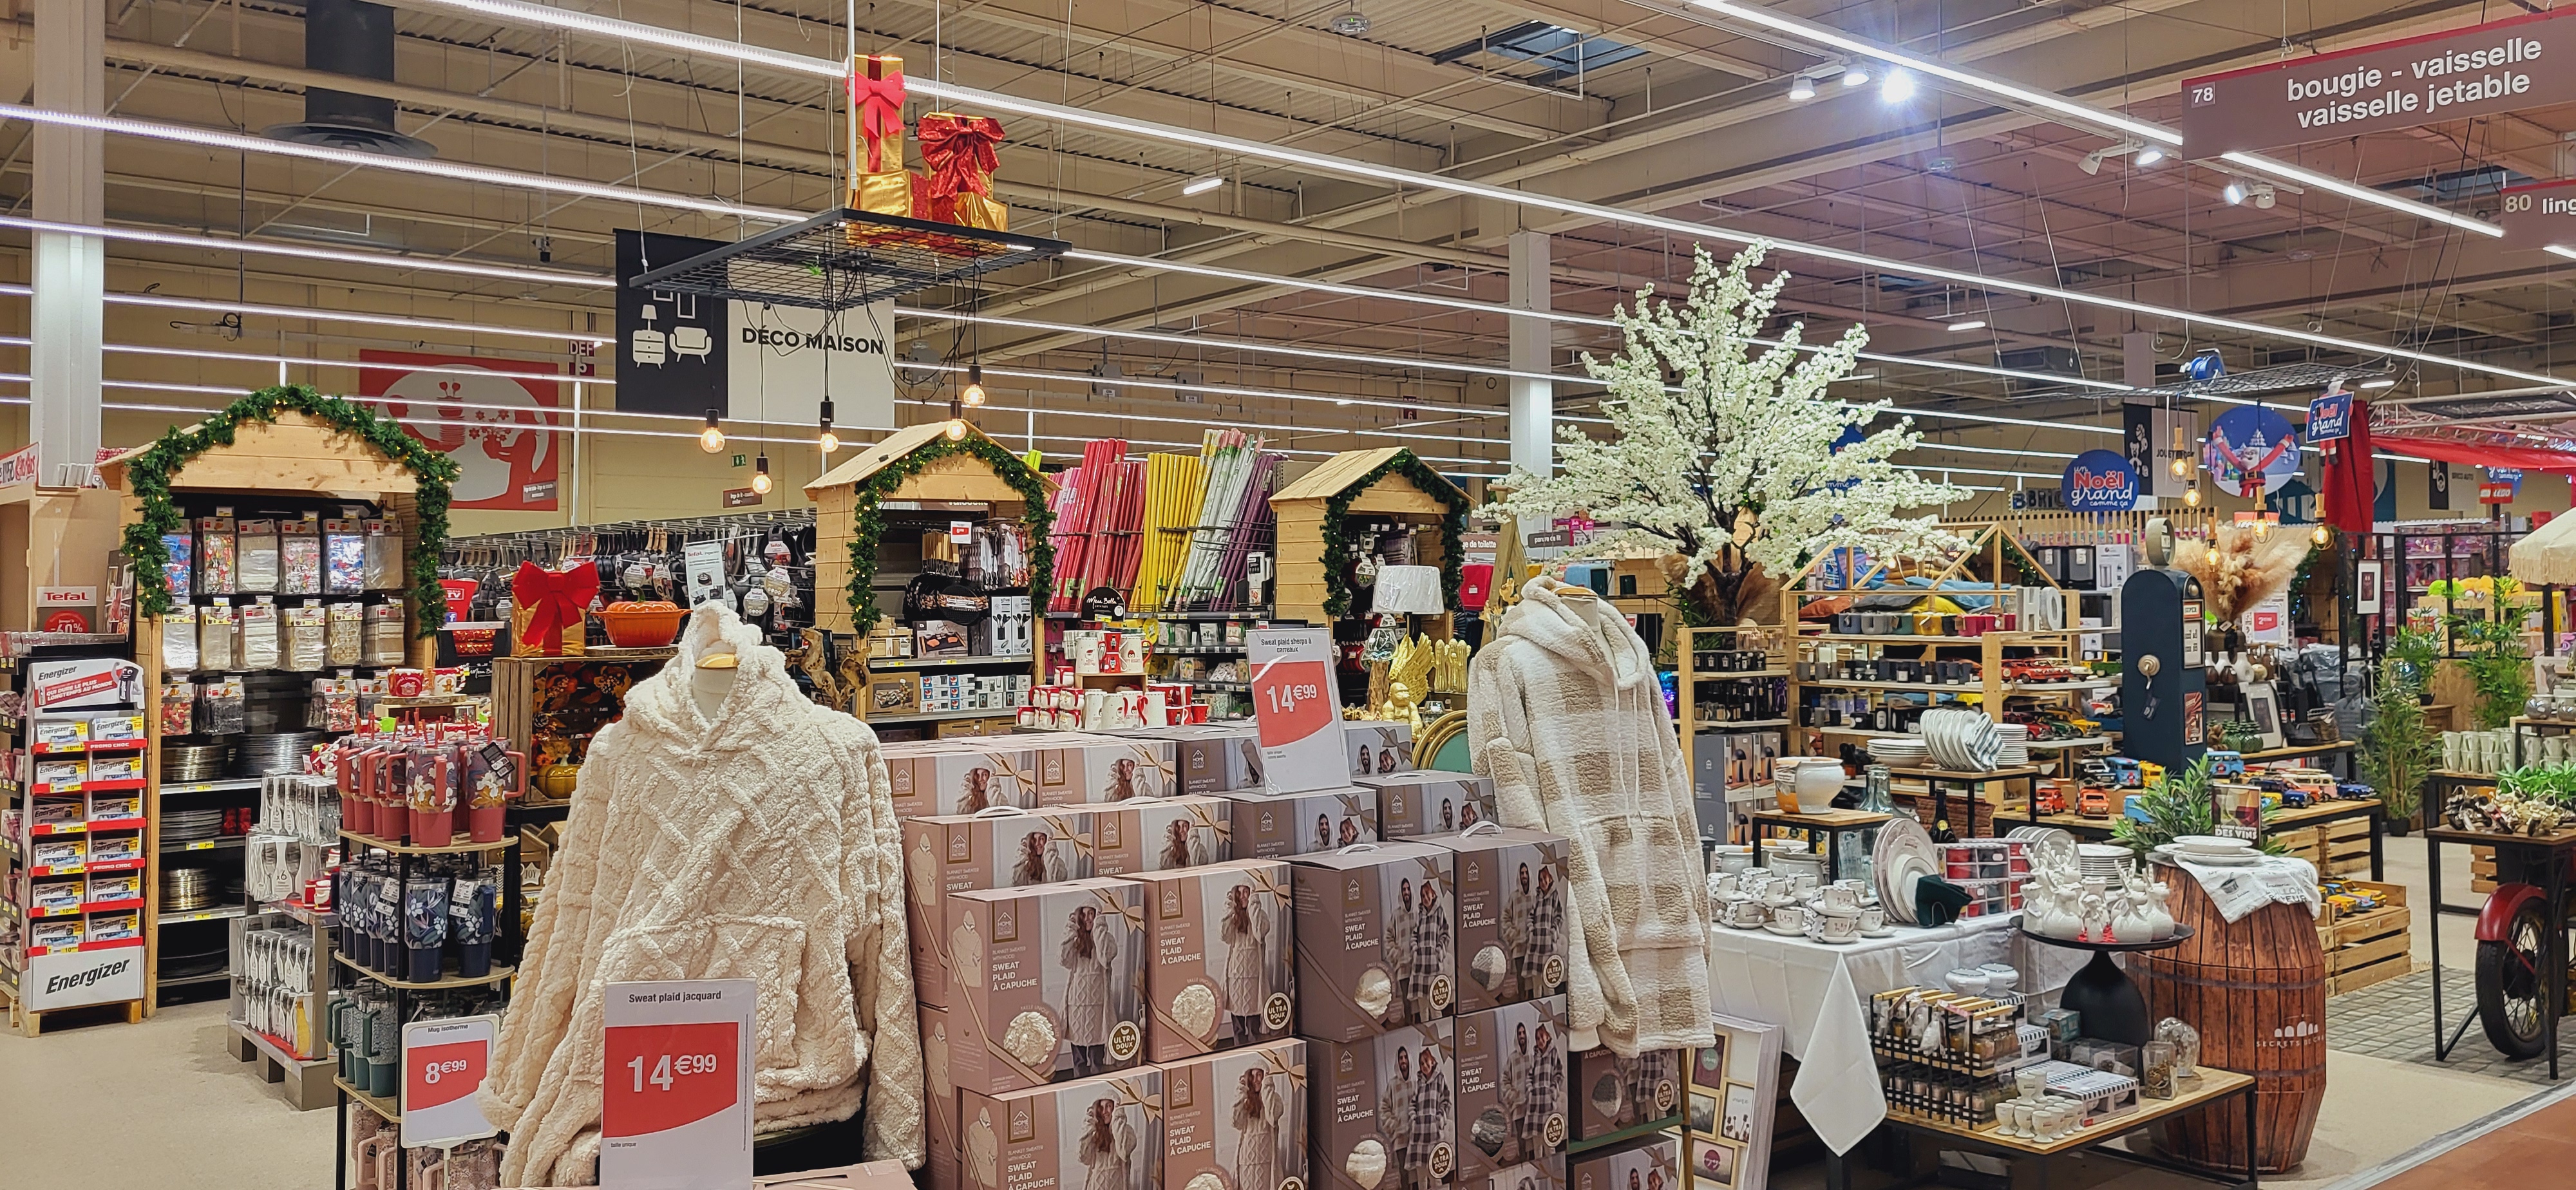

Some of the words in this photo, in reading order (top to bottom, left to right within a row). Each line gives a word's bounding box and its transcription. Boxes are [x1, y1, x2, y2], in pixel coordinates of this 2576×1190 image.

[2287, 66, 2382, 102] bougie
[2411, 36, 2542, 80] vaisselle
[2192, 86, 2214, 104] 78
[2297, 91, 2419, 129] vaisselle
[2426, 71, 2531, 113] jetable
[2505, 194, 2532, 213] 80
[742, 325, 800, 347] DÉCO
[806, 332, 884, 355] MAISON
[570, 341, 593, 356] DEF
[2074, 471, 2124, 490] Noël
[2071, 481, 2133, 506] grand
[2493, 489, 2511, 498] LEGO
[1477, 540, 1497, 549] toilette
[44, 592, 89, 601] Tefal
[1261, 638, 1276, 646] Sweat
[1276, 638, 1290, 647] plaid
[1291, 637, 1307, 647] sherpa
[1308, 636, 1312, 645] à
[38, 665, 77, 681] Energizer
[82, 679, 97, 688] PLUS
[47, 688, 82, 701] LONGTEMPS
[1266, 684, 1317, 713] 14€99
[39, 726, 70, 735] Energizer
[97, 719, 127, 731] Energizer
[39, 764, 70, 773] Energizer
[94, 761, 124, 771] Energizer
[93, 801, 122, 812] Energizer
[2215, 828, 2233, 837] DES
[2235, 829, 2257, 840] VINS
[37, 844, 68, 856] Energizer
[524, 870, 536, 879] JOY
[1099, 866, 1124, 875] SWEAT
[946, 882, 973, 891] SWEAT
[1463, 903, 1484, 912] SWEAT
[1463, 912, 1481, 920] PLAID
[1345, 923, 1366, 933] SWEAT
[1463, 920, 1468, 929] À
[1468, 918, 1496, 928] CAPUCHE
[1160, 936, 1186, 947] SWEAT
[1345, 933, 1363, 942] PLAID
[1345, 941, 1350, 951] À
[1350, 938, 1379, 950] CAPUCHE
[1160, 947, 1182, 956] PLAID
[1161, 956, 1167, 965] À
[1168, 952, 1202, 965] CAPUCHE
[992, 961, 1020, 972] SWEAT
[45, 958, 130, 995] Energizer
[992, 972, 1016, 981] PLAID
[992, 981, 999, 992] À
[1000, 978, 1037, 990] CAPUCHE
[1433, 986, 1448, 996] ULTRA
[629, 992, 656, 1005] Sweat
[659, 991, 680, 1005] plaid
[682, 990, 722, 1004] jacquard
[1268, 1005, 1287, 1014] ULTRA
[441, 1023, 469, 1032] isotherme
[1113, 1034, 1135, 1044] ULTRA
[1116, 1041, 1133, 1050] DOUX
[425, 1059, 468, 1084] 8€99
[627, 1053, 717, 1092] 14€99
[1461, 1067, 1483, 1077] SWEAT
[1461, 1076, 1480, 1085] PLAID
[1461, 1085, 1466, 1094] À
[1467, 1081, 1496, 1093] CAPUCHE
[1337, 1094, 1359, 1105] SWEAT
[1337, 1104, 1356, 1114] PLAID
[1337, 1114, 1343, 1123] À
[1343, 1109, 1374, 1122] CAPUCHE
[1170, 1125, 1195, 1137] SWEAT
[1170, 1136, 1191, 1146] PLAID
[1170, 1146, 1176, 1157] À
[1177, 1140, 1211, 1153] CAPUCHE
[1433, 1154, 1449, 1164] ULTRA
[1007, 1160, 1037, 1173] SWEAT
[1008, 1172, 1032, 1183] PLAID
[1016, 1177, 1056, 1190] CAPUCHE
